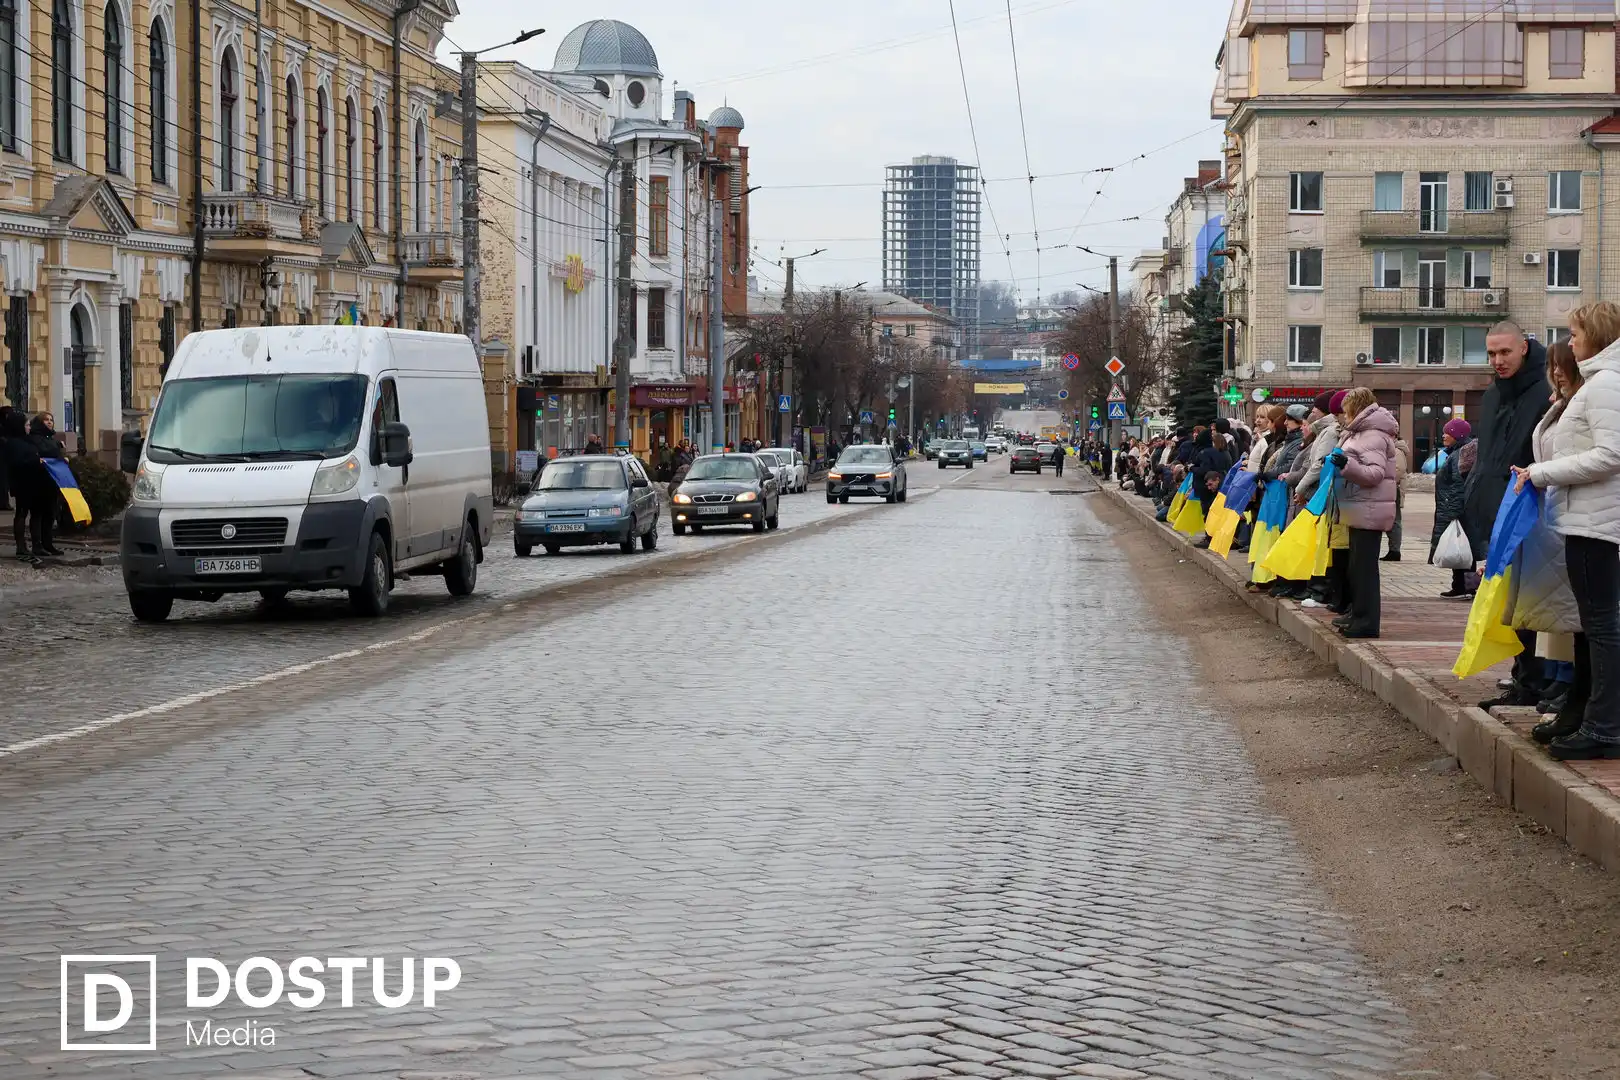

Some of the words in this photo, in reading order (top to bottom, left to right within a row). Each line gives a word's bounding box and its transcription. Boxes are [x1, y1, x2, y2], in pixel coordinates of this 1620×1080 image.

[202, 562, 216, 570] BA
[219, 560, 240, 570] 7368
[243, 560, 256, 570] HB
